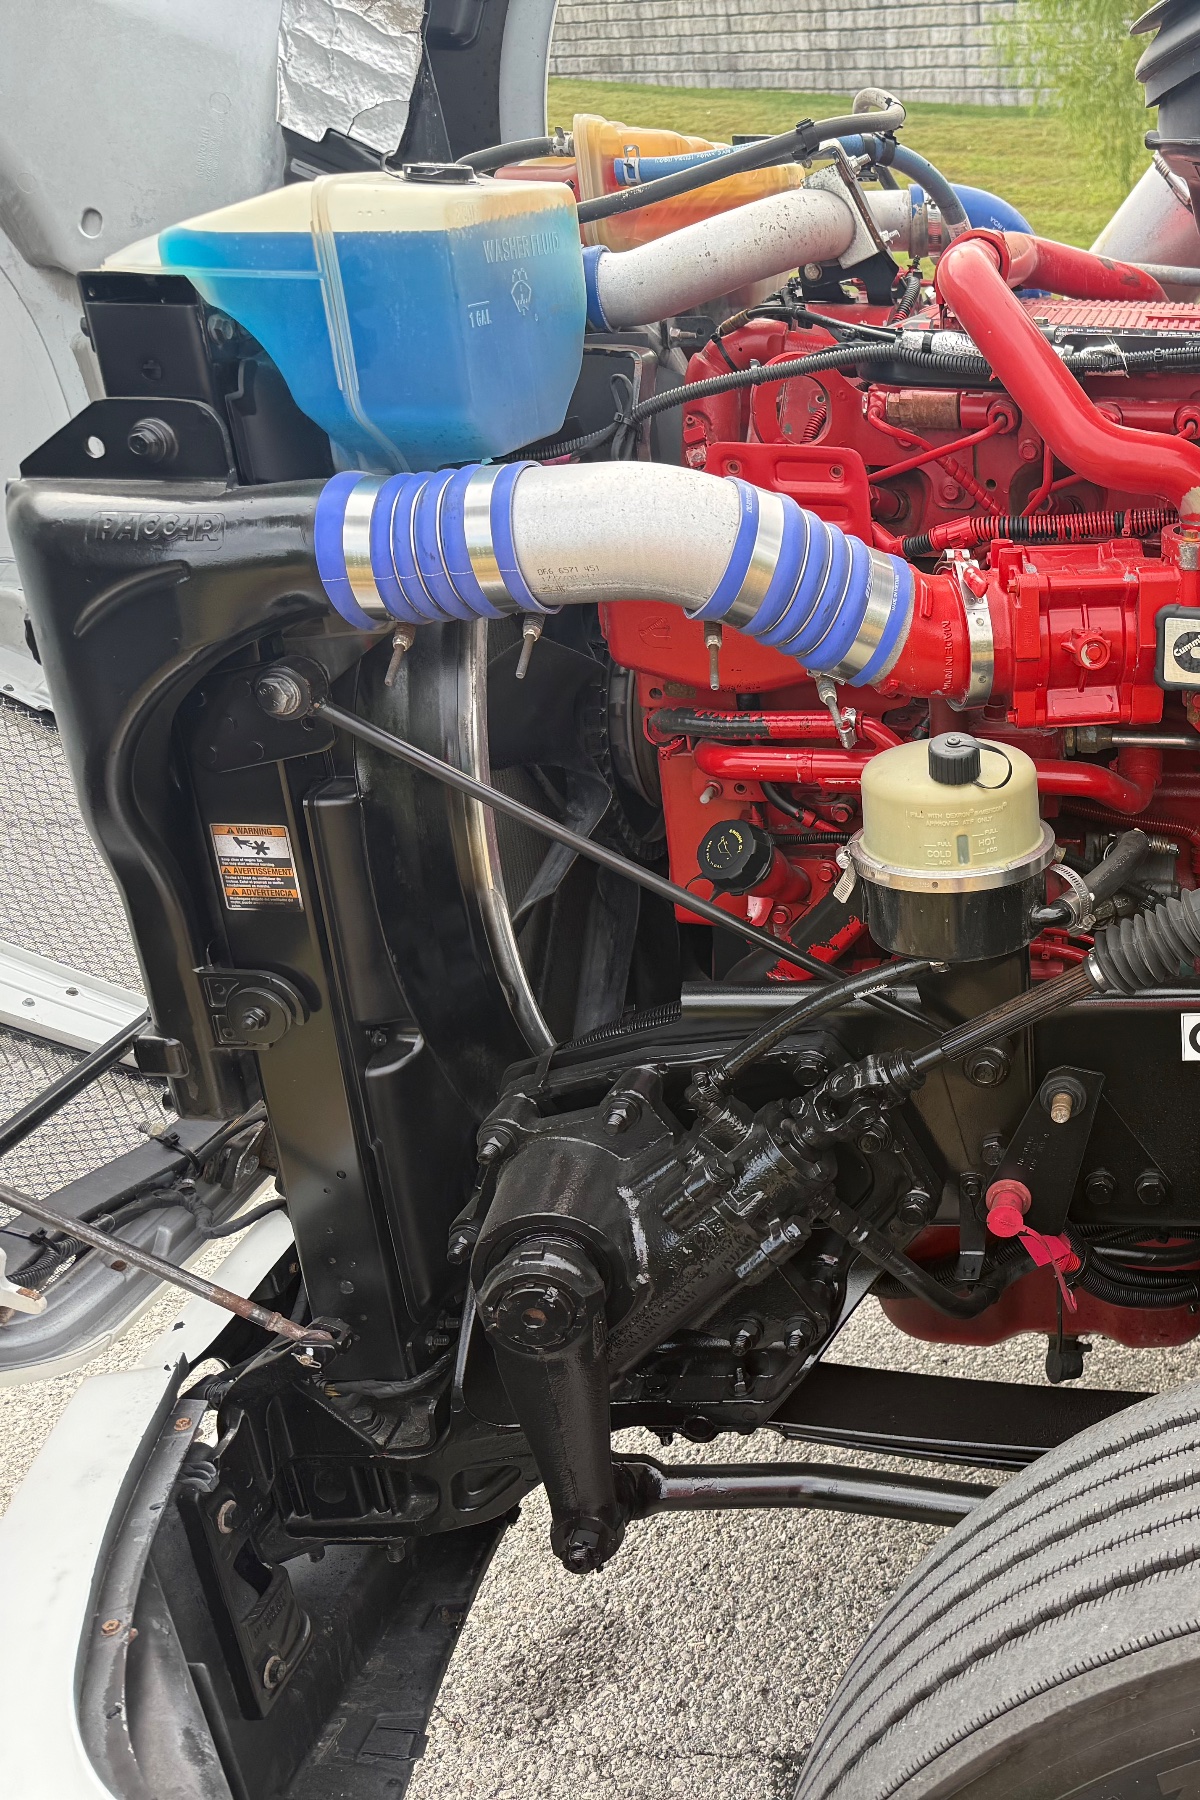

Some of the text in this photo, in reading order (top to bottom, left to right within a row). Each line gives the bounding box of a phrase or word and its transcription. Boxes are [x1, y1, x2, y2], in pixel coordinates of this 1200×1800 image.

[483, 232, 559, 263] WASHER FLUID
[96, 511, 222, 541] PACCAR
[941, 620, 953, 654] MADE
[235, 827, 272, 835] WARNING
[978, 837, 996, 846] HOT
[233, 867, 292, 875] AVERTISSEMENT
[241, 889, 293, 897] ADVERTENCIA
